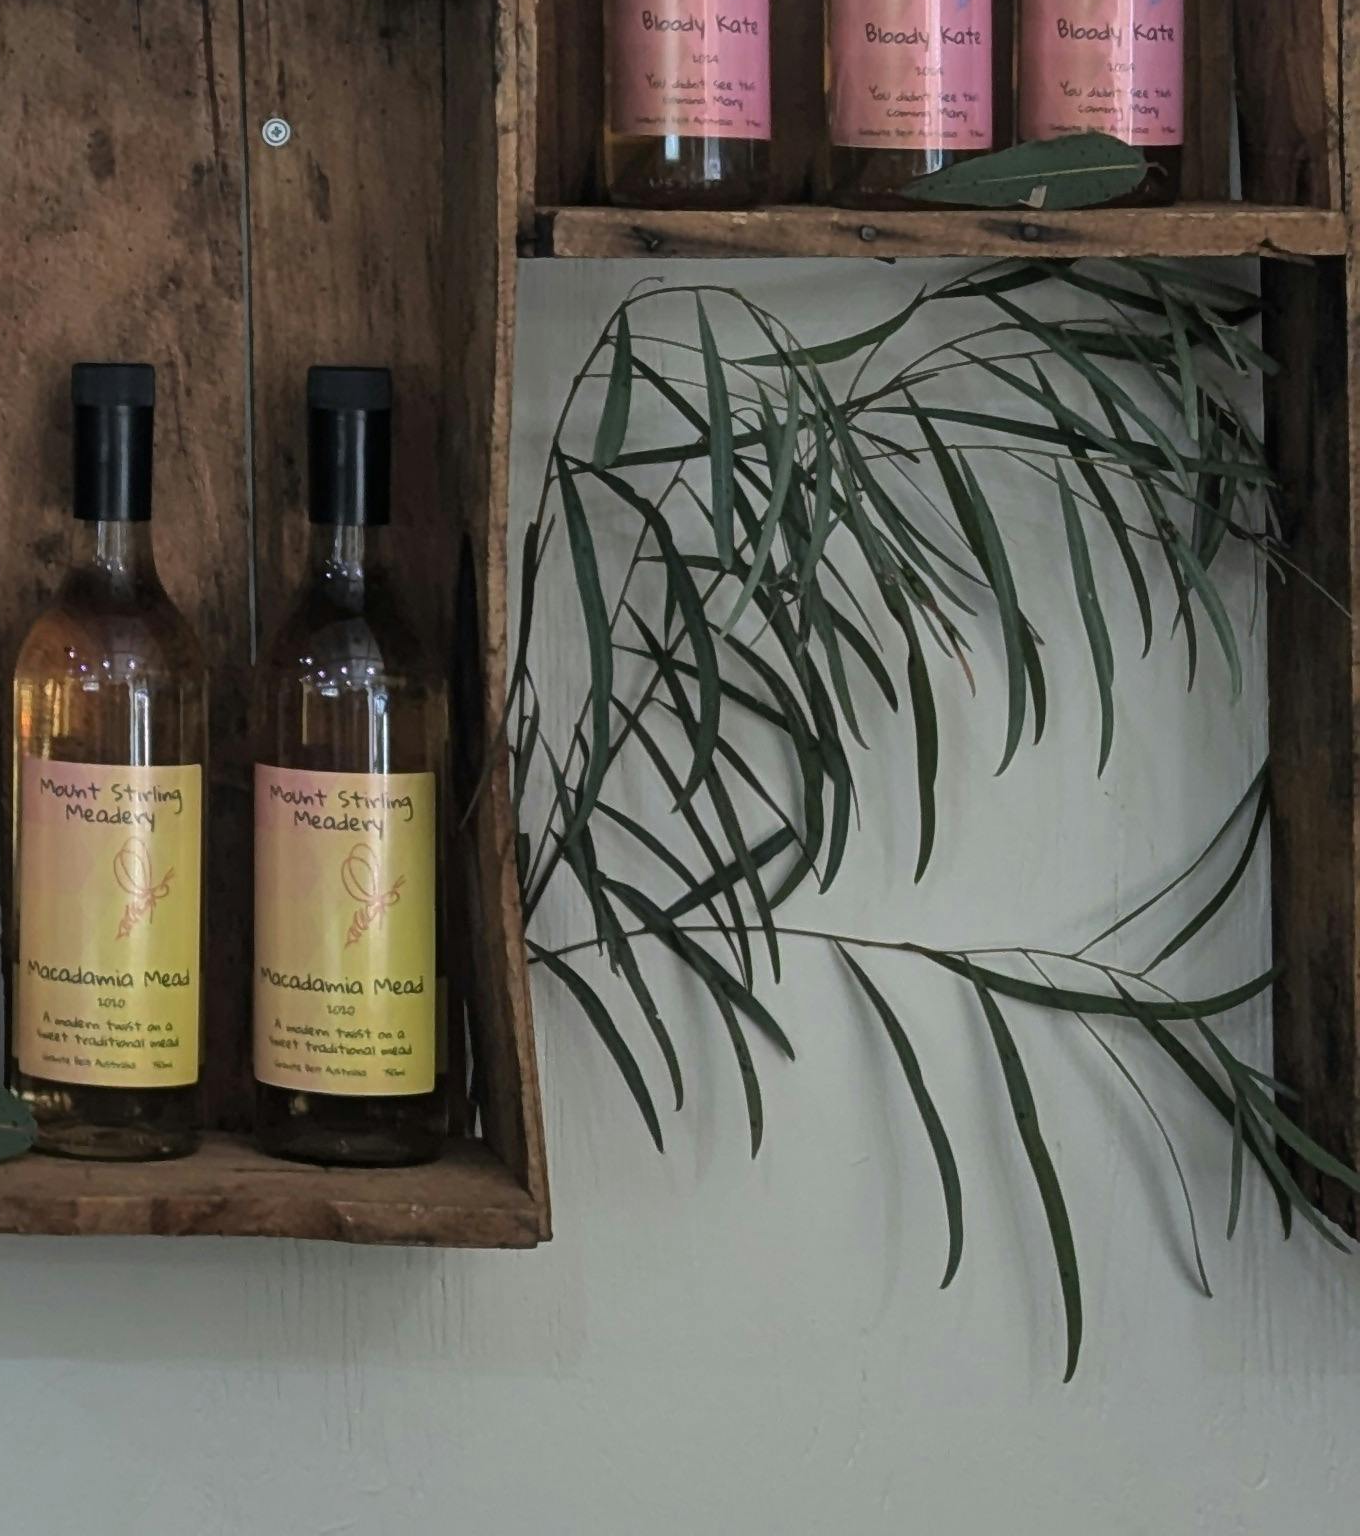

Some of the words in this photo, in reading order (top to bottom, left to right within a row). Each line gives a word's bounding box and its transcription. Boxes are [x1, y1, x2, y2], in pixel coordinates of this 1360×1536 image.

[642, 12, 705, 40] Bloody
[716, 15, 758, 36] Kate
[865, 22, 930, 53] Bloody
[941, 25, 982, 45] Kate
[1057, 18, 1122, 48] Bloody
[1133, 21, 1175, 42] Kate
[40, 778, 101, 800] Mount
[111, 783, 183, 814] Stirling
[270, 784, 327, 808] Mount
[338, 790, 413, 821] Stirling
[66, 804, 155, 832] Meadery
[294, 810, 384, 839] Meadery
[28, 959, 134, 987] Macadamia
[144, 968, 190, 987] Mead
[261, 965, 364, 996] Macadamia
[374, 976, 425, 996] Mead
